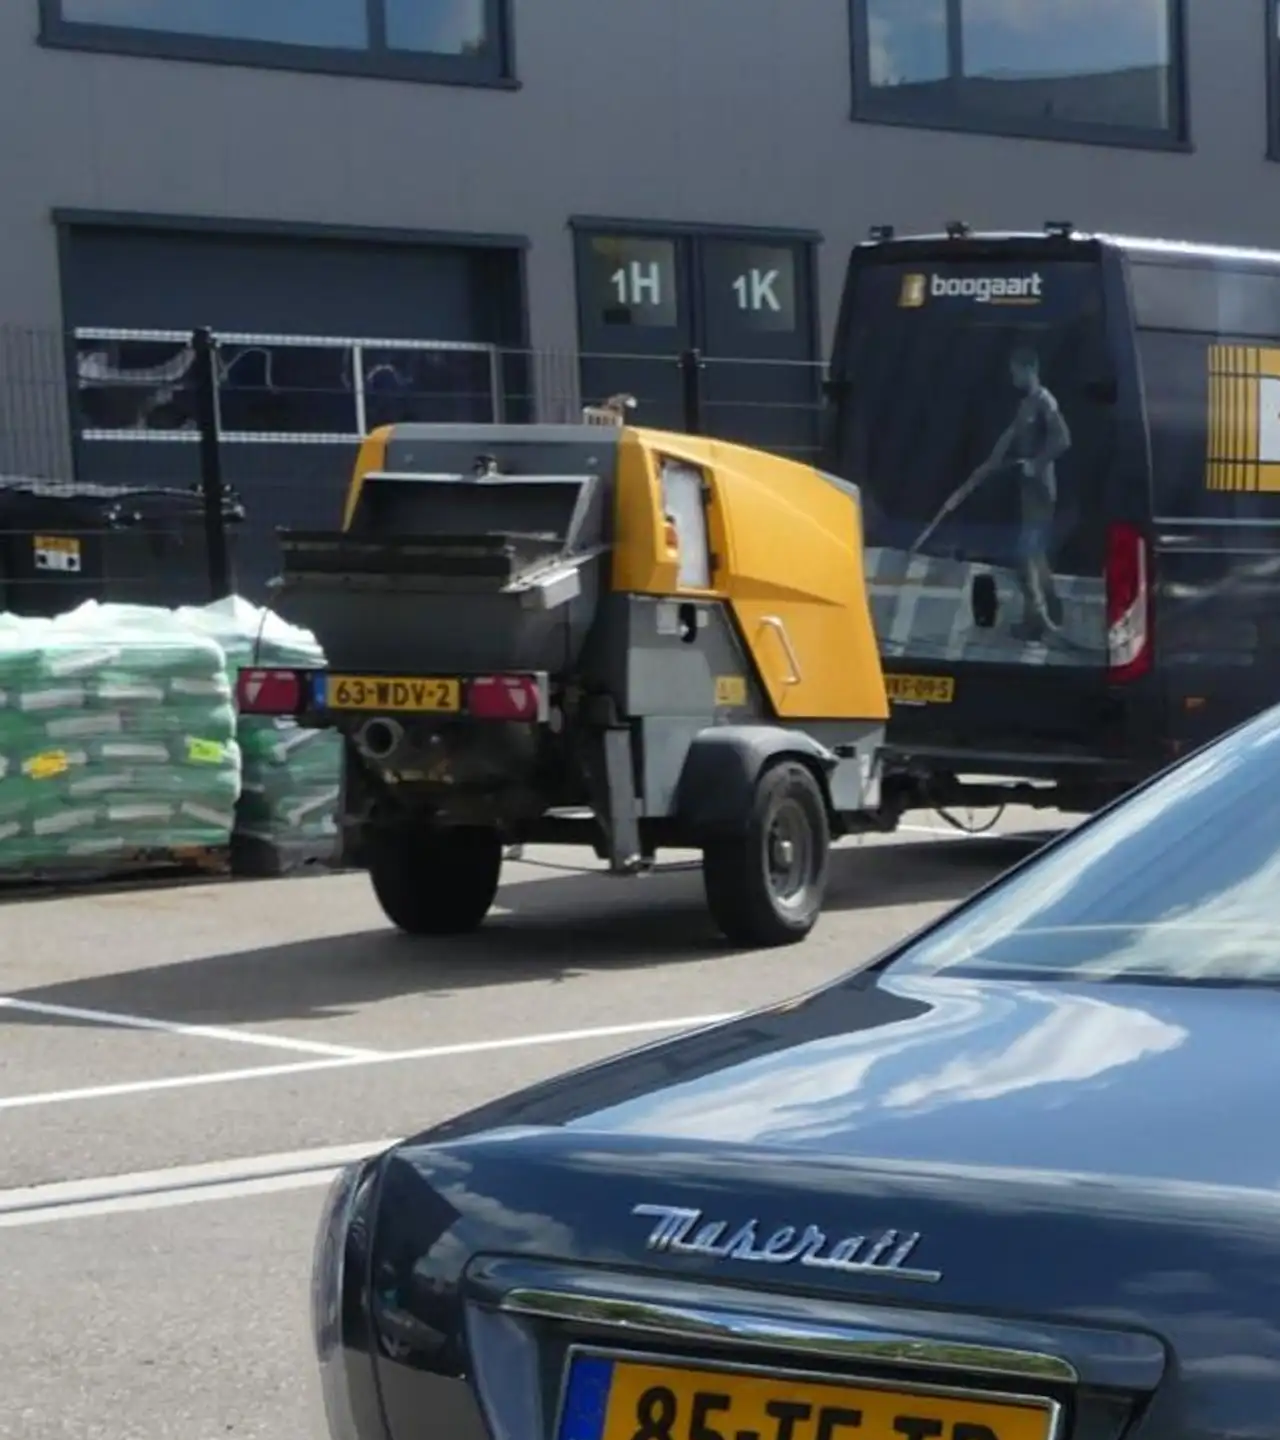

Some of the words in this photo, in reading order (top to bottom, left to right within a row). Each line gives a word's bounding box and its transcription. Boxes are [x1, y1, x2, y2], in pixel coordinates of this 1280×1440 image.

[610, 261, 660, 305] 1H
[732, 269, 781, 311] 1K
[931, 272, 1042, 302] boogaart
[335, 680, 452, 707] 63-WDV-2
[632, 1204, 943, 1282] Maserati
